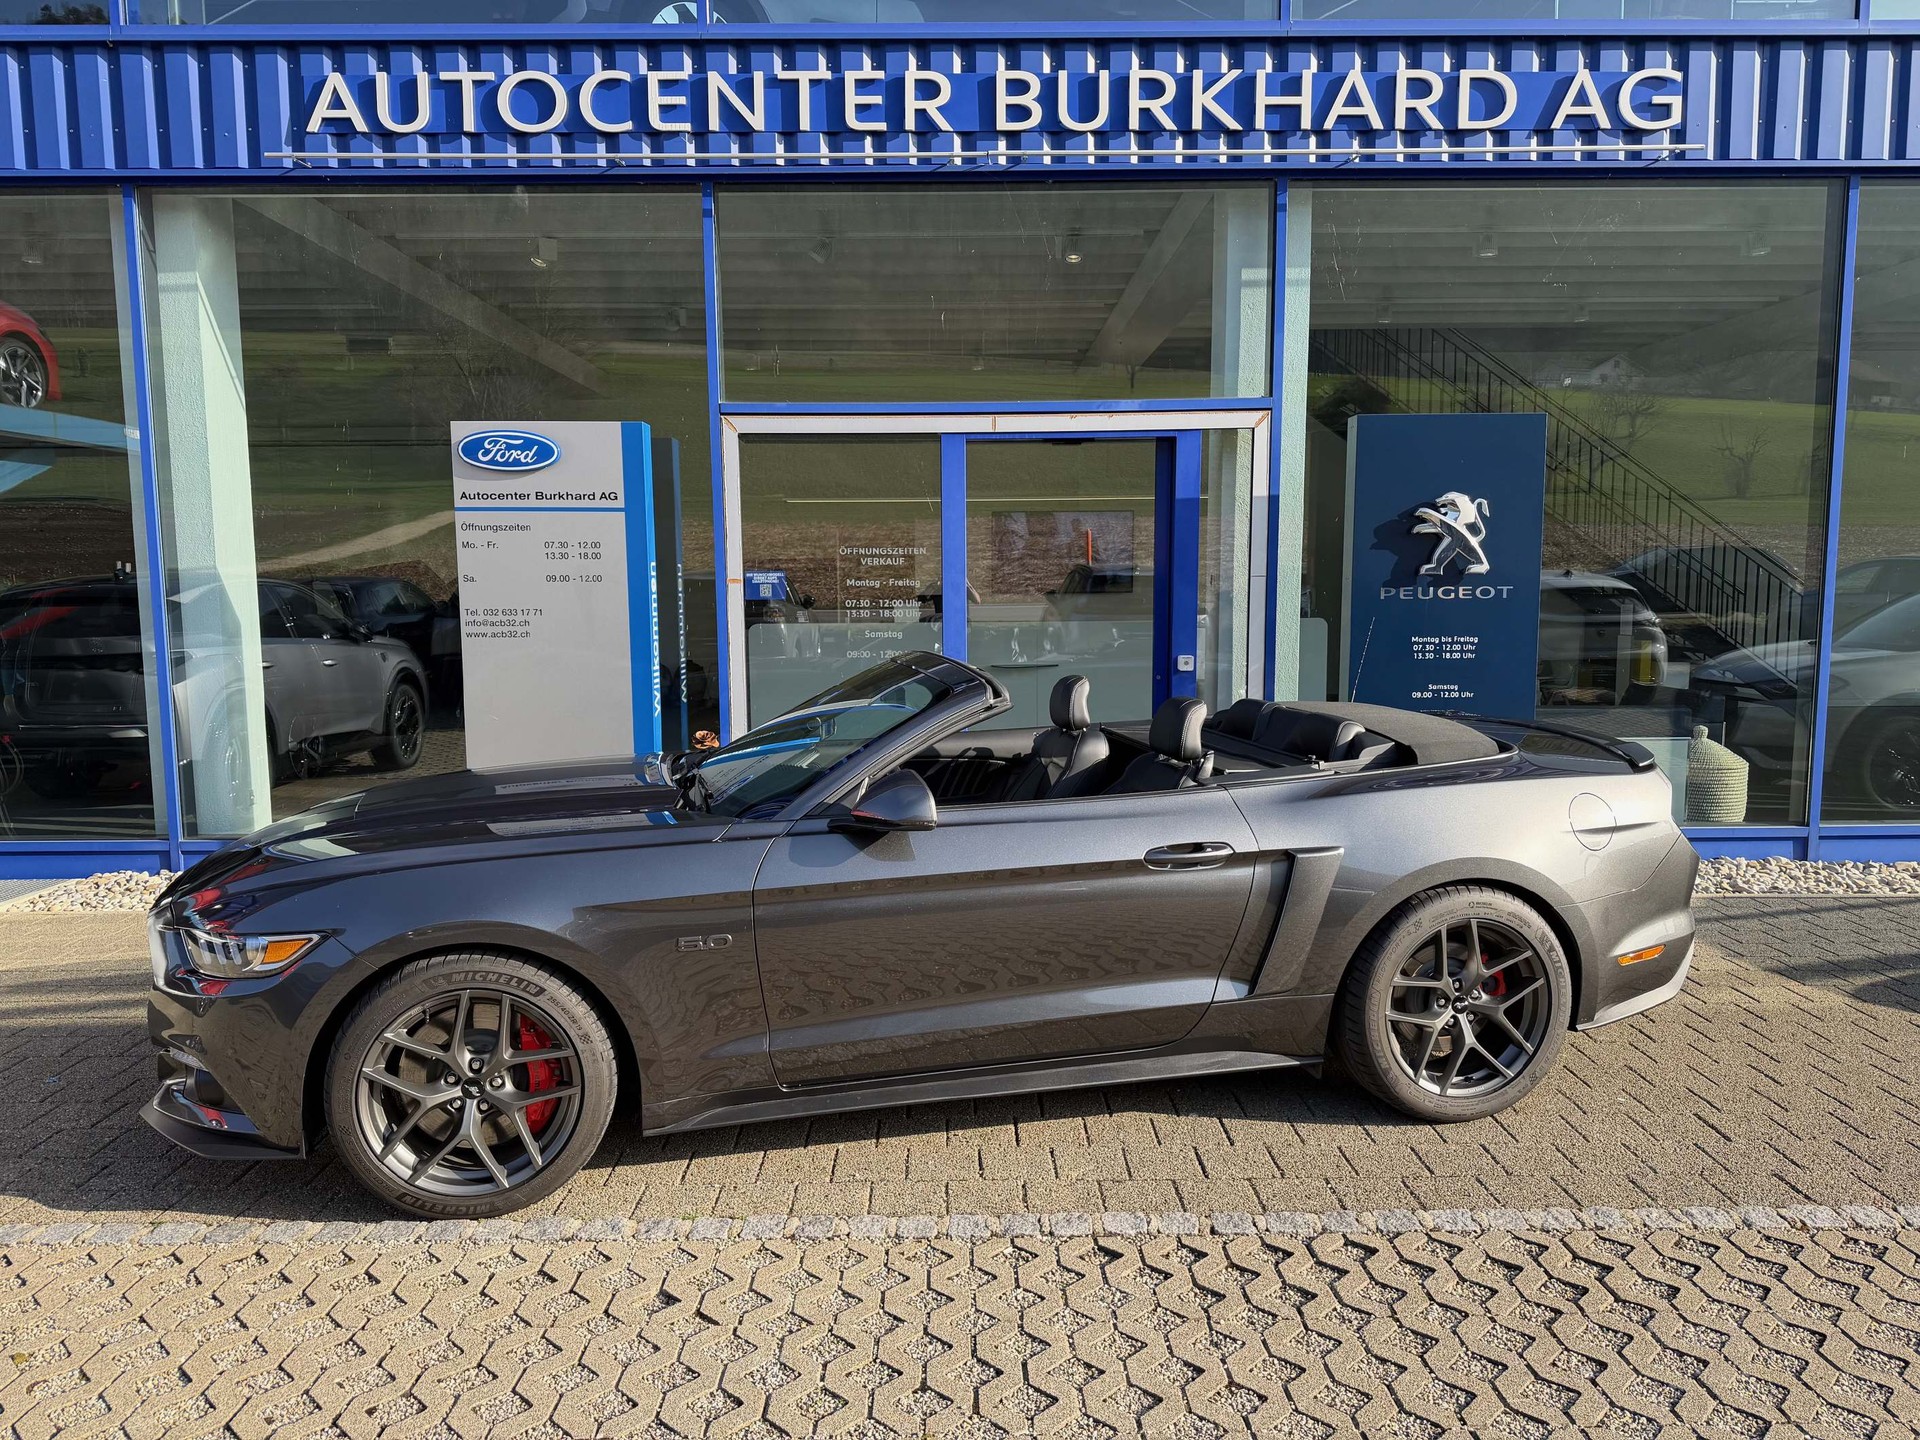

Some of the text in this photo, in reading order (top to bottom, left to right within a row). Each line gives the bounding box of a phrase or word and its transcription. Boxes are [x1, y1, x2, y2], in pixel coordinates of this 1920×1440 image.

[306, 68, 1684, 134] AUTOCENTER BURKHARD AG
[478, 437, 538, 463] Ford
[460, 491, 618, 501] Autocenter Burkhard AG
[460, 521, 531, 533] Öffnungszeiten
[461, 541, 478, 549] Mo.
[486, 541, 499, 549] Fr.
[543, 541, 568, 549] 07.30
[577, 541, 601, 549] 12.00
[840, 545, 926, 555] ÖFFNUNGSZEITEN
[545, 552, 569, 560] 13.30
[578, 552, 602, 560] 18.00
[860, 557, 905, 566] VERKAUF
[462, 574, 477, 583] Sa.
[545, 574, 570, 583] 09.00
[579, 574, 603, 583] 12.00
[846, 579, 880, 588] Montag
[889, 578, 920, 588] Freitag
[1380, 586, 1513, 600] PEUGEOT
[845, 599, 870, 608] 07:30
[879, 599, 904, 608] 12:00
[905, 599, 922, 607] Uhr
[464, 608, 543, 616] Tel. 032 633 17 71
[846, 609, 870, 618] 13:30
[879, 609, 904, 618] 18:00
[905, 609, 922, 618] Uhr
[465, 619, 530, 627] info@acb32.ch
[465, 630, 531, 638] www.acb32.ch
[864, 630, 903, 639] Samstag
[650, 561, 661, 717] Willkommen
[846, 650, 870, 658] 09:00
[677, 933, 732, 952] 5.0
[451, 971, 540, 995] MICHELIN
[400, 1194, 490, 1215] MICHELIN
